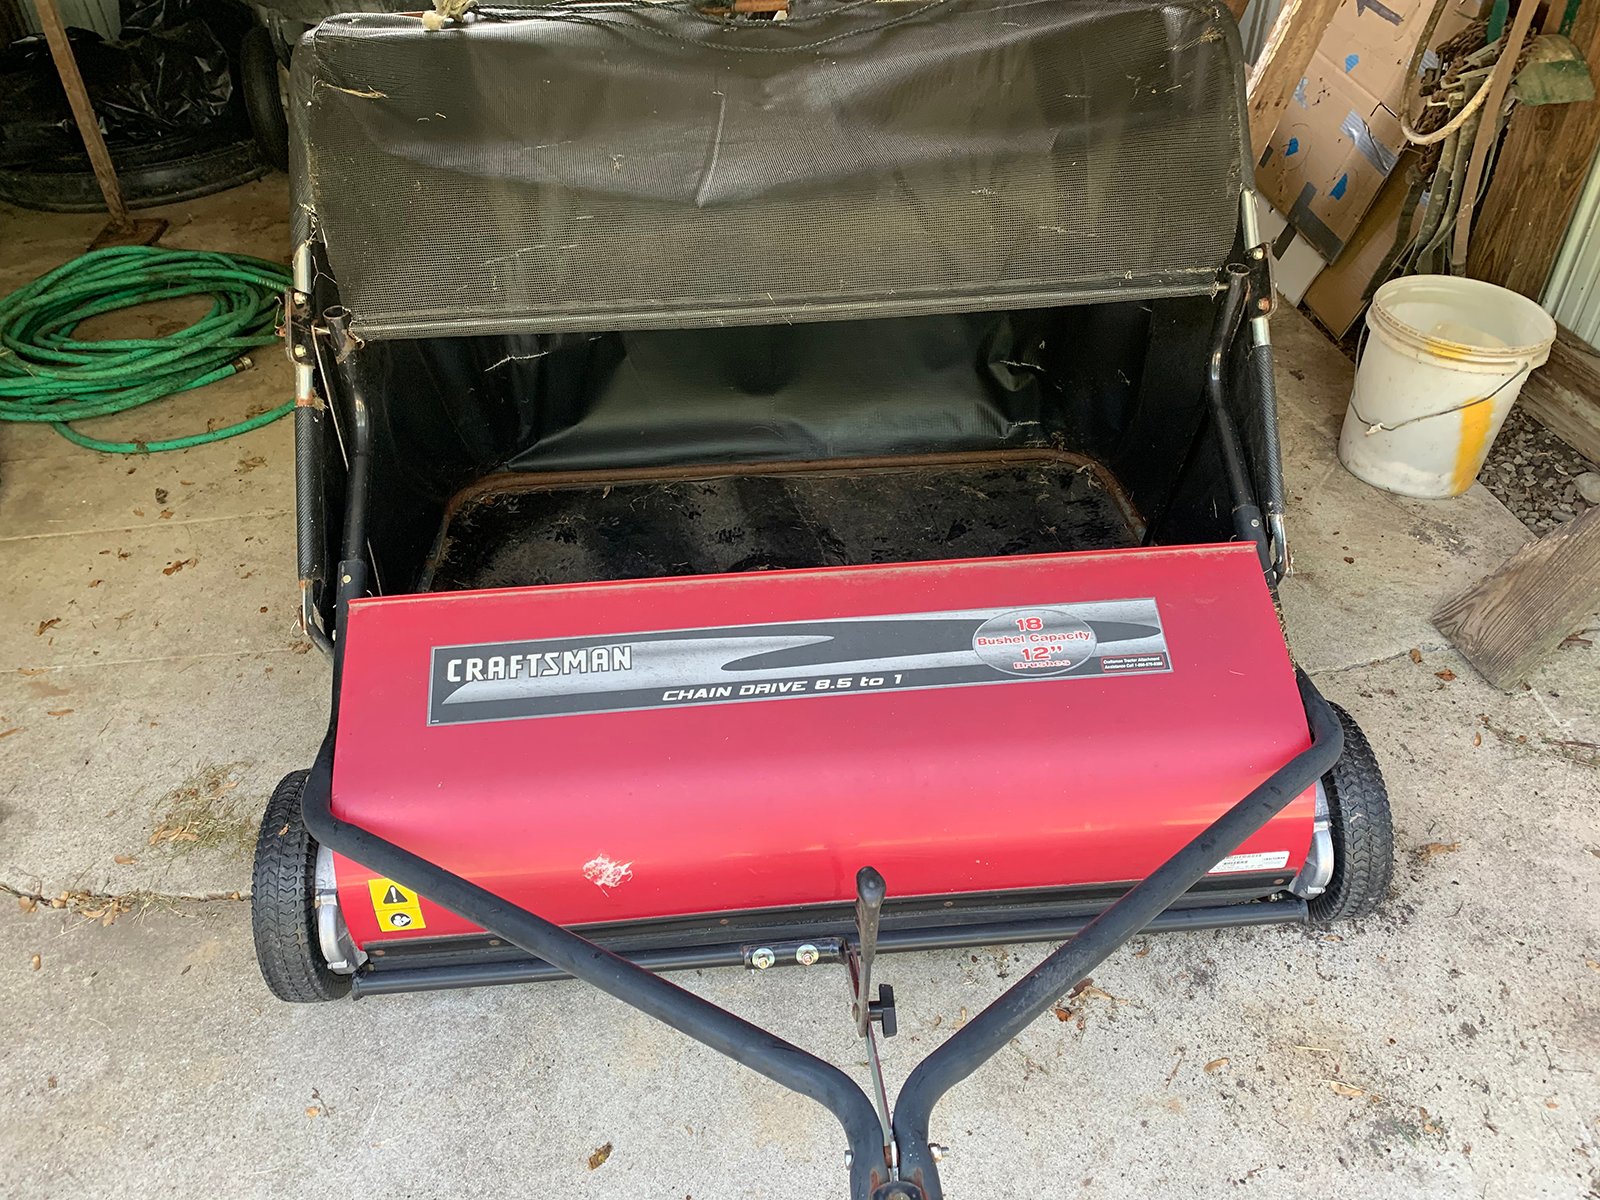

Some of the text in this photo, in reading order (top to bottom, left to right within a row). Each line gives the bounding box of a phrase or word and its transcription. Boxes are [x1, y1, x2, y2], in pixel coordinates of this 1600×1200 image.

[1016, 617, 1043, 631] 18
[977, 631, 1091, 646] Bushel Capacity
[446, 646, 633, 683] CRAFTSMAN
[1013, 660, 1071, 669] Brushes
[662, 674, 902, 702] CHAIN DRIVE 8.5 to 1
